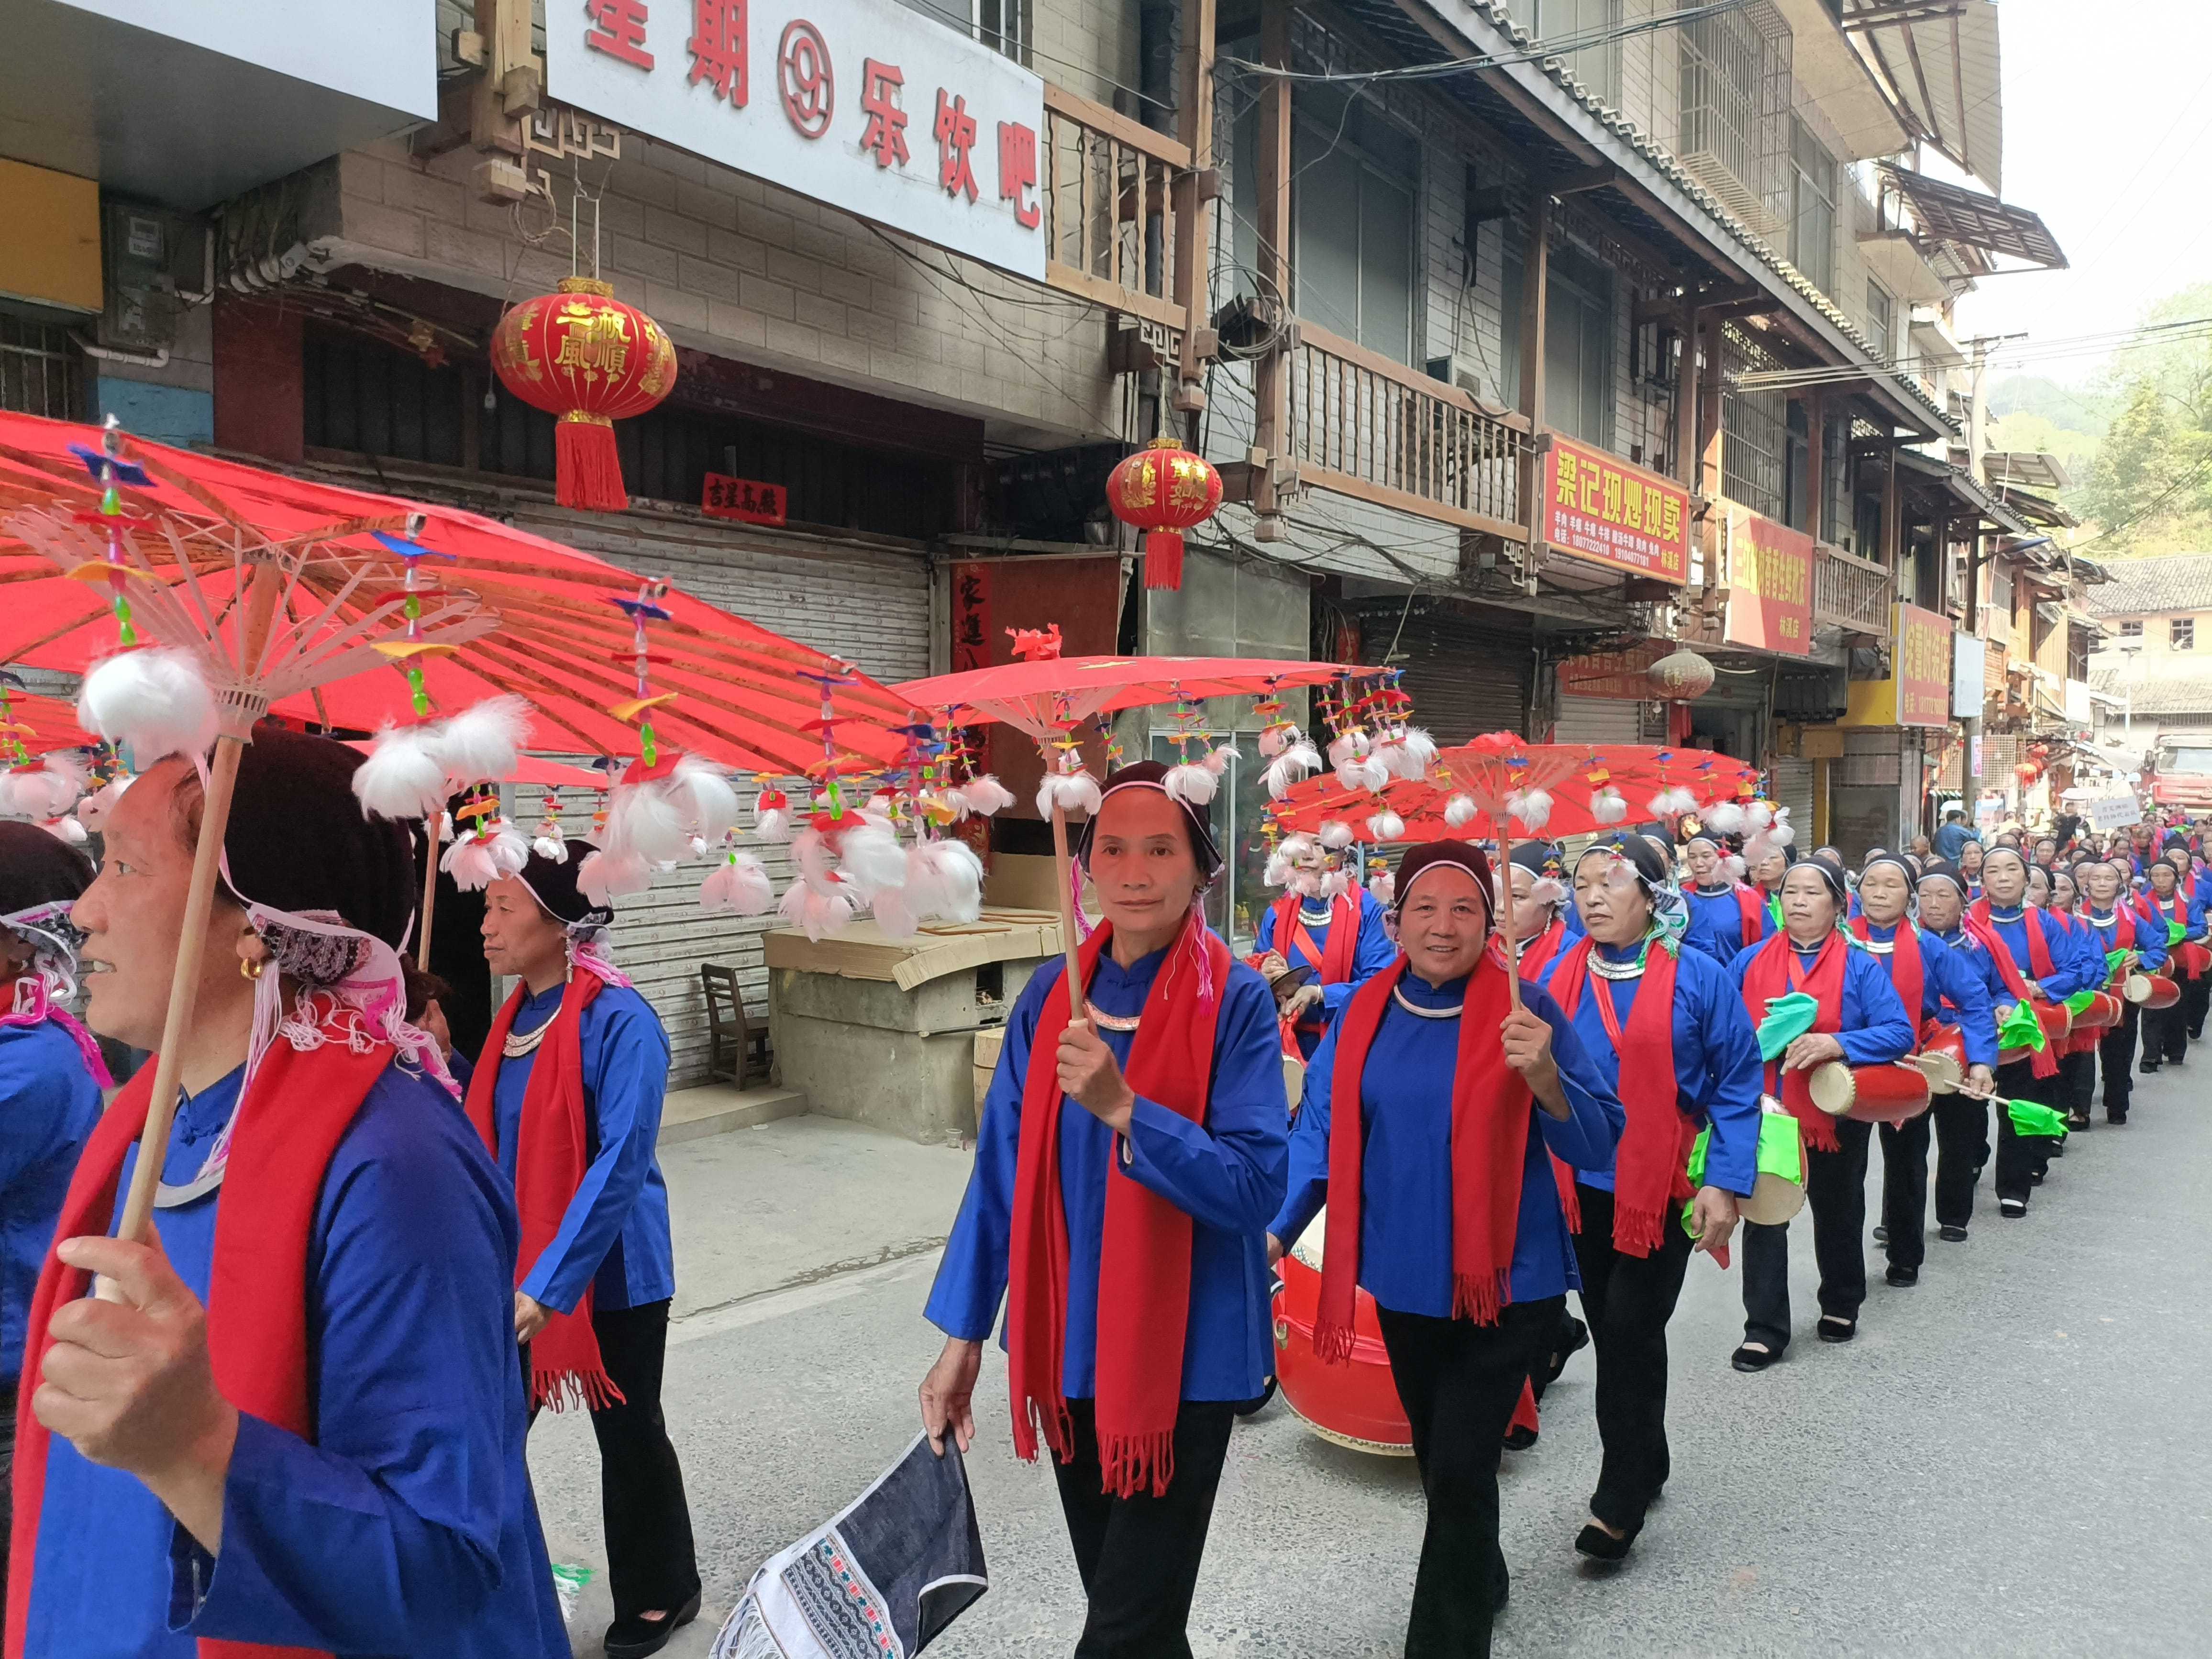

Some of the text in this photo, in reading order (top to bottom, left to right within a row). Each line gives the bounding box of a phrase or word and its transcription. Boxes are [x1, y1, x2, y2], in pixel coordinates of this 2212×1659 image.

[1556, 448, 1681, 543] 梁记现炒现卖
[1555, 510, 1567, 528] 羊肉
[1661, 548, 1680, 571] 林溪店
